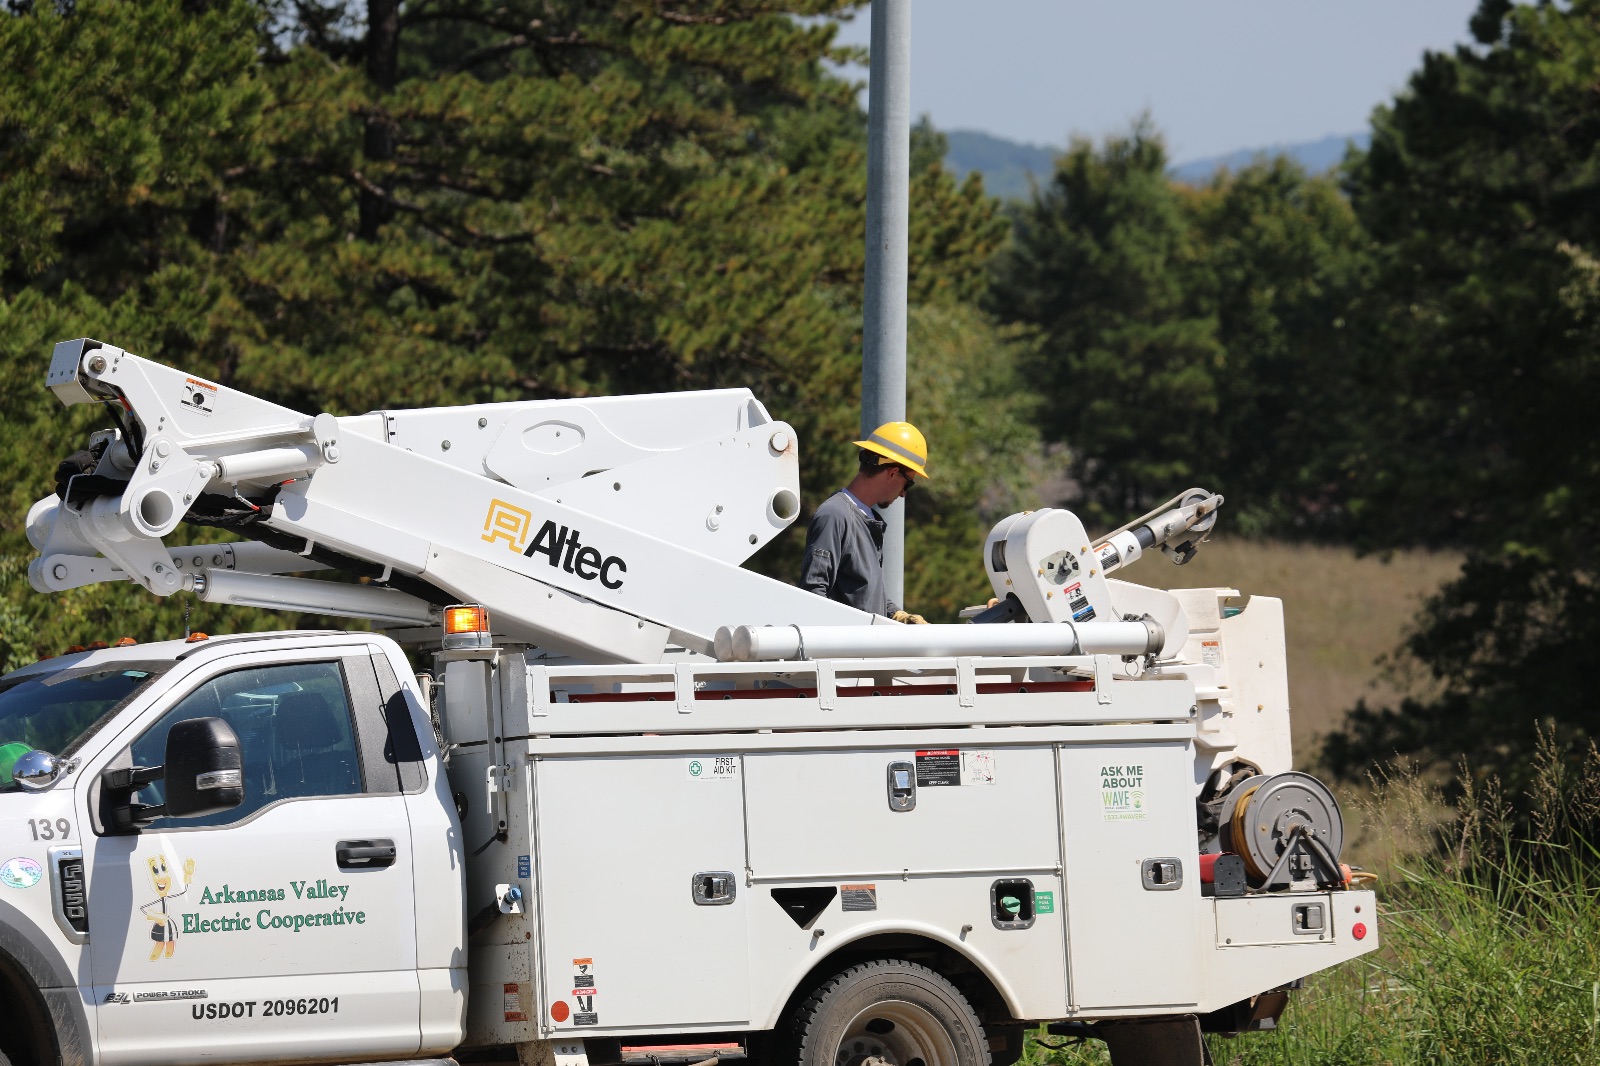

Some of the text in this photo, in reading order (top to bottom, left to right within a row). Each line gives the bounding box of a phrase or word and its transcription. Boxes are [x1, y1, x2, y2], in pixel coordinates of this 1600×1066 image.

[523, 519, 627, 590] Altec
[715, 757, 734, 766] FIRST
[713, 765, 737, 775] AID KIT
[1100, 765, 1143, 777] ASK ME
[1102, 777, 1142, 788] ABOUT
[1102, 790, 1130, 806] WAVE
[28, 818, 70, 841] 139
[199, 879, 349, 905] Arkansas Valley
[182, 906, 366, 934] Electric Cooperative
[170, 989, 207, 997] STROKE
[192, 997, 339, 1019] USDOT 2096201
